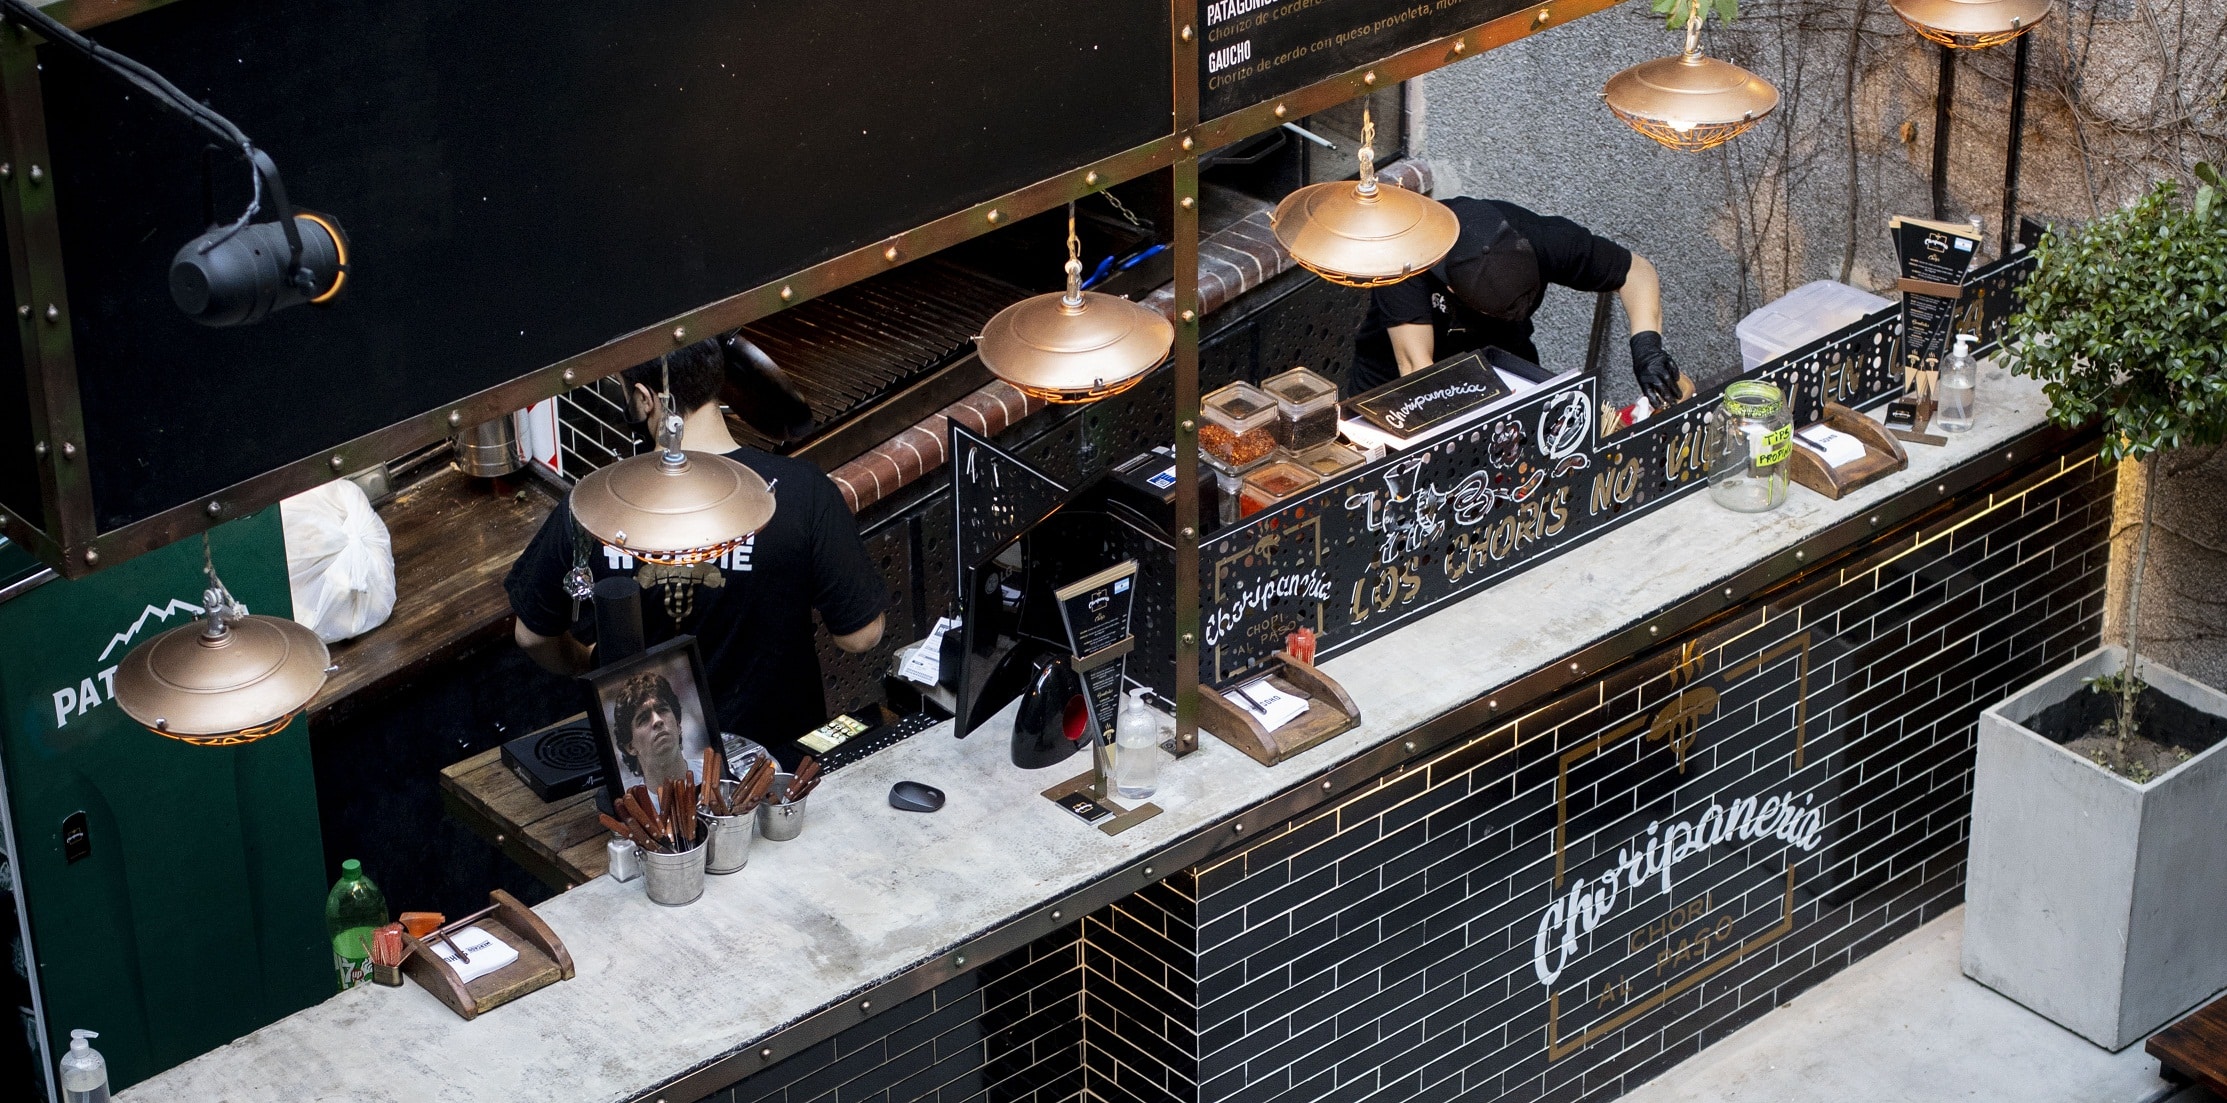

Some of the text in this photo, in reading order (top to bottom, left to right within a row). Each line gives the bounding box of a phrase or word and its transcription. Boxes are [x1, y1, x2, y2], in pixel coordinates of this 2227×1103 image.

[1208, 19, 1252, 42] Chorizo
[1255, 12, 1269, 26] de
[1208, 66, 1253, 91] Chorizo
[1257, 58, 1271, 73] de
[1274, 46, 1307, 66] cerdo
[1310, 38, 1332, 52] con
[1335, 25, 1371, 46] queso
[1374, 4, 1433, 34] provoleta,
[1208, 40, 1251, 73] GAUCHO
[1350, 556, 1421, 625] LOS
[1444, 486, 1569, 583] CHORIS
[1590, 457, 1640, 516] NO
[1821, 354, 1865, 407] EN
[1261, 621, 1297, 644] PASO
[1630, 892, 1713, 952] CHORI
[1598, 915, 1734, 1009] AL PASO
